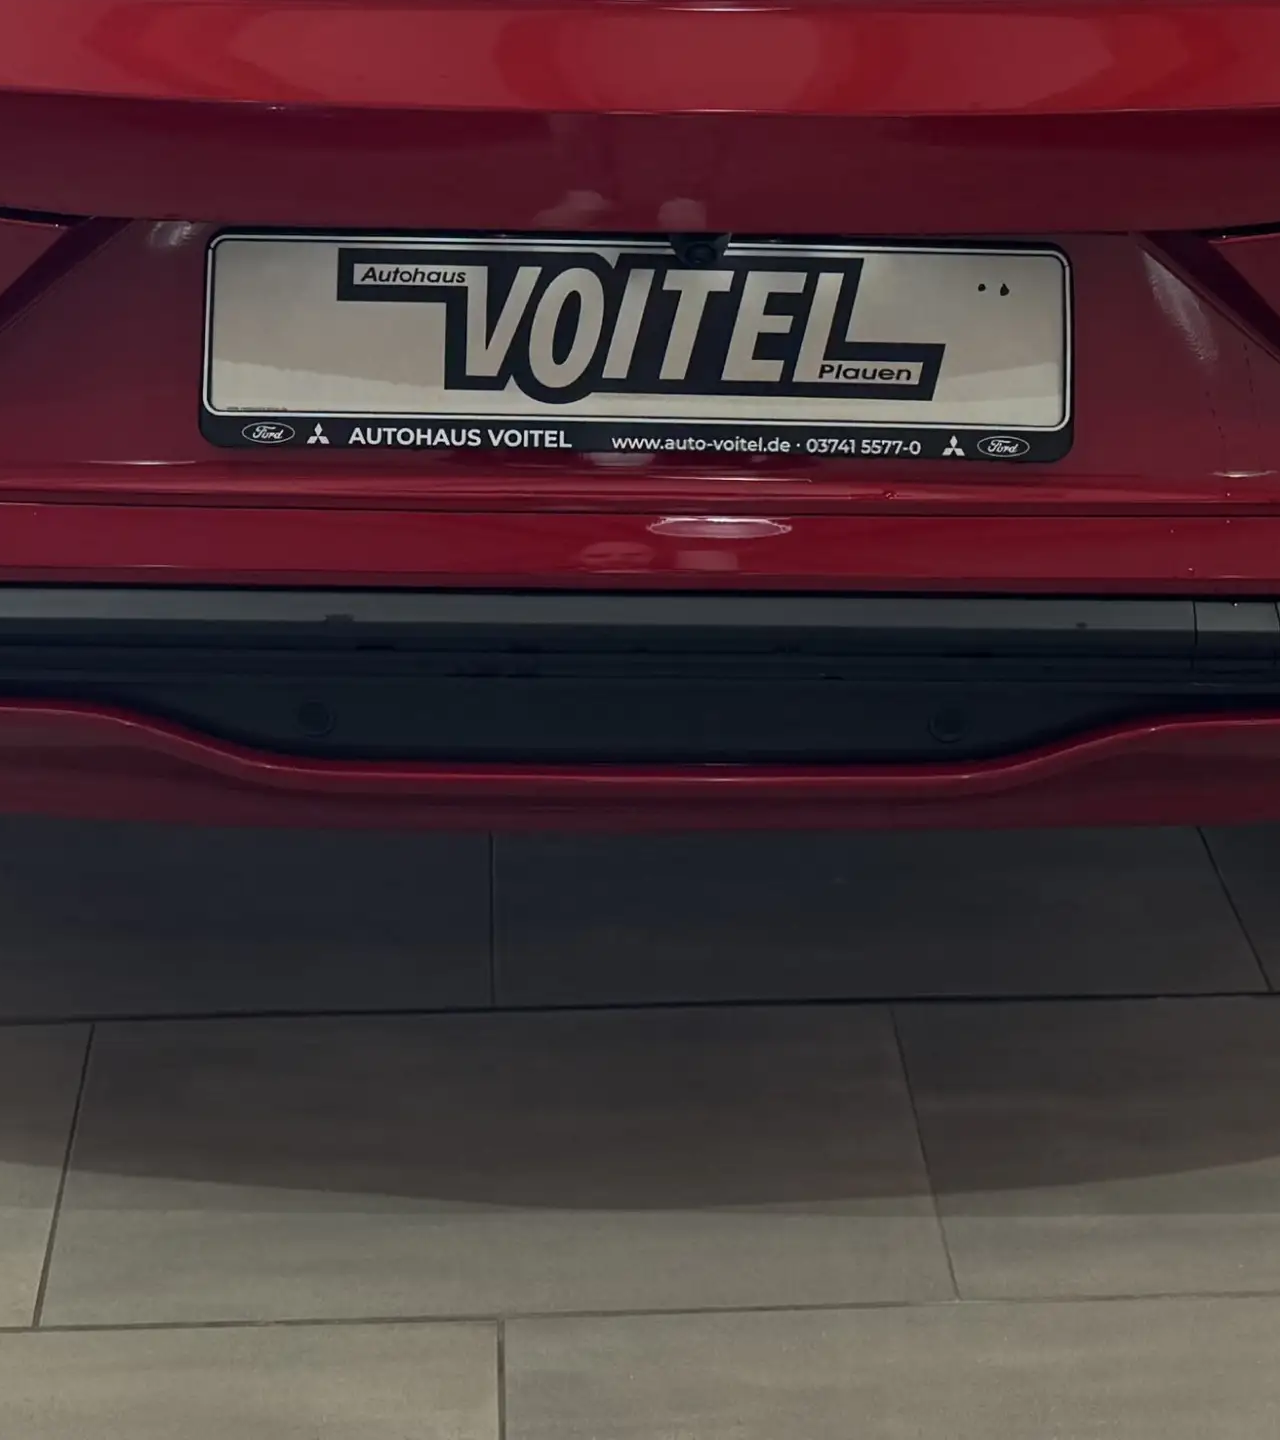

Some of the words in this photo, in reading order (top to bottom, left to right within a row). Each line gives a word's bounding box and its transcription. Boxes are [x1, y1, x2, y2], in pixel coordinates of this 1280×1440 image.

[360, 266, 467, 285] Autohaus
[462, 264, 925, 390] VOITEL
[818, 363, 912, 382] Plauen
[251, 424, 284, 441] Ford
[348, 427, 481, 447] AUTOHAUS
[487, 429, 572, 449] VOITEL
[611, 435, 791, 454] www.auto-voitel.de
[806, 439, 856, 455] 03741
[861, 440, 922, 456] 5577-0
[986, 438, 1019, 455] Ford
